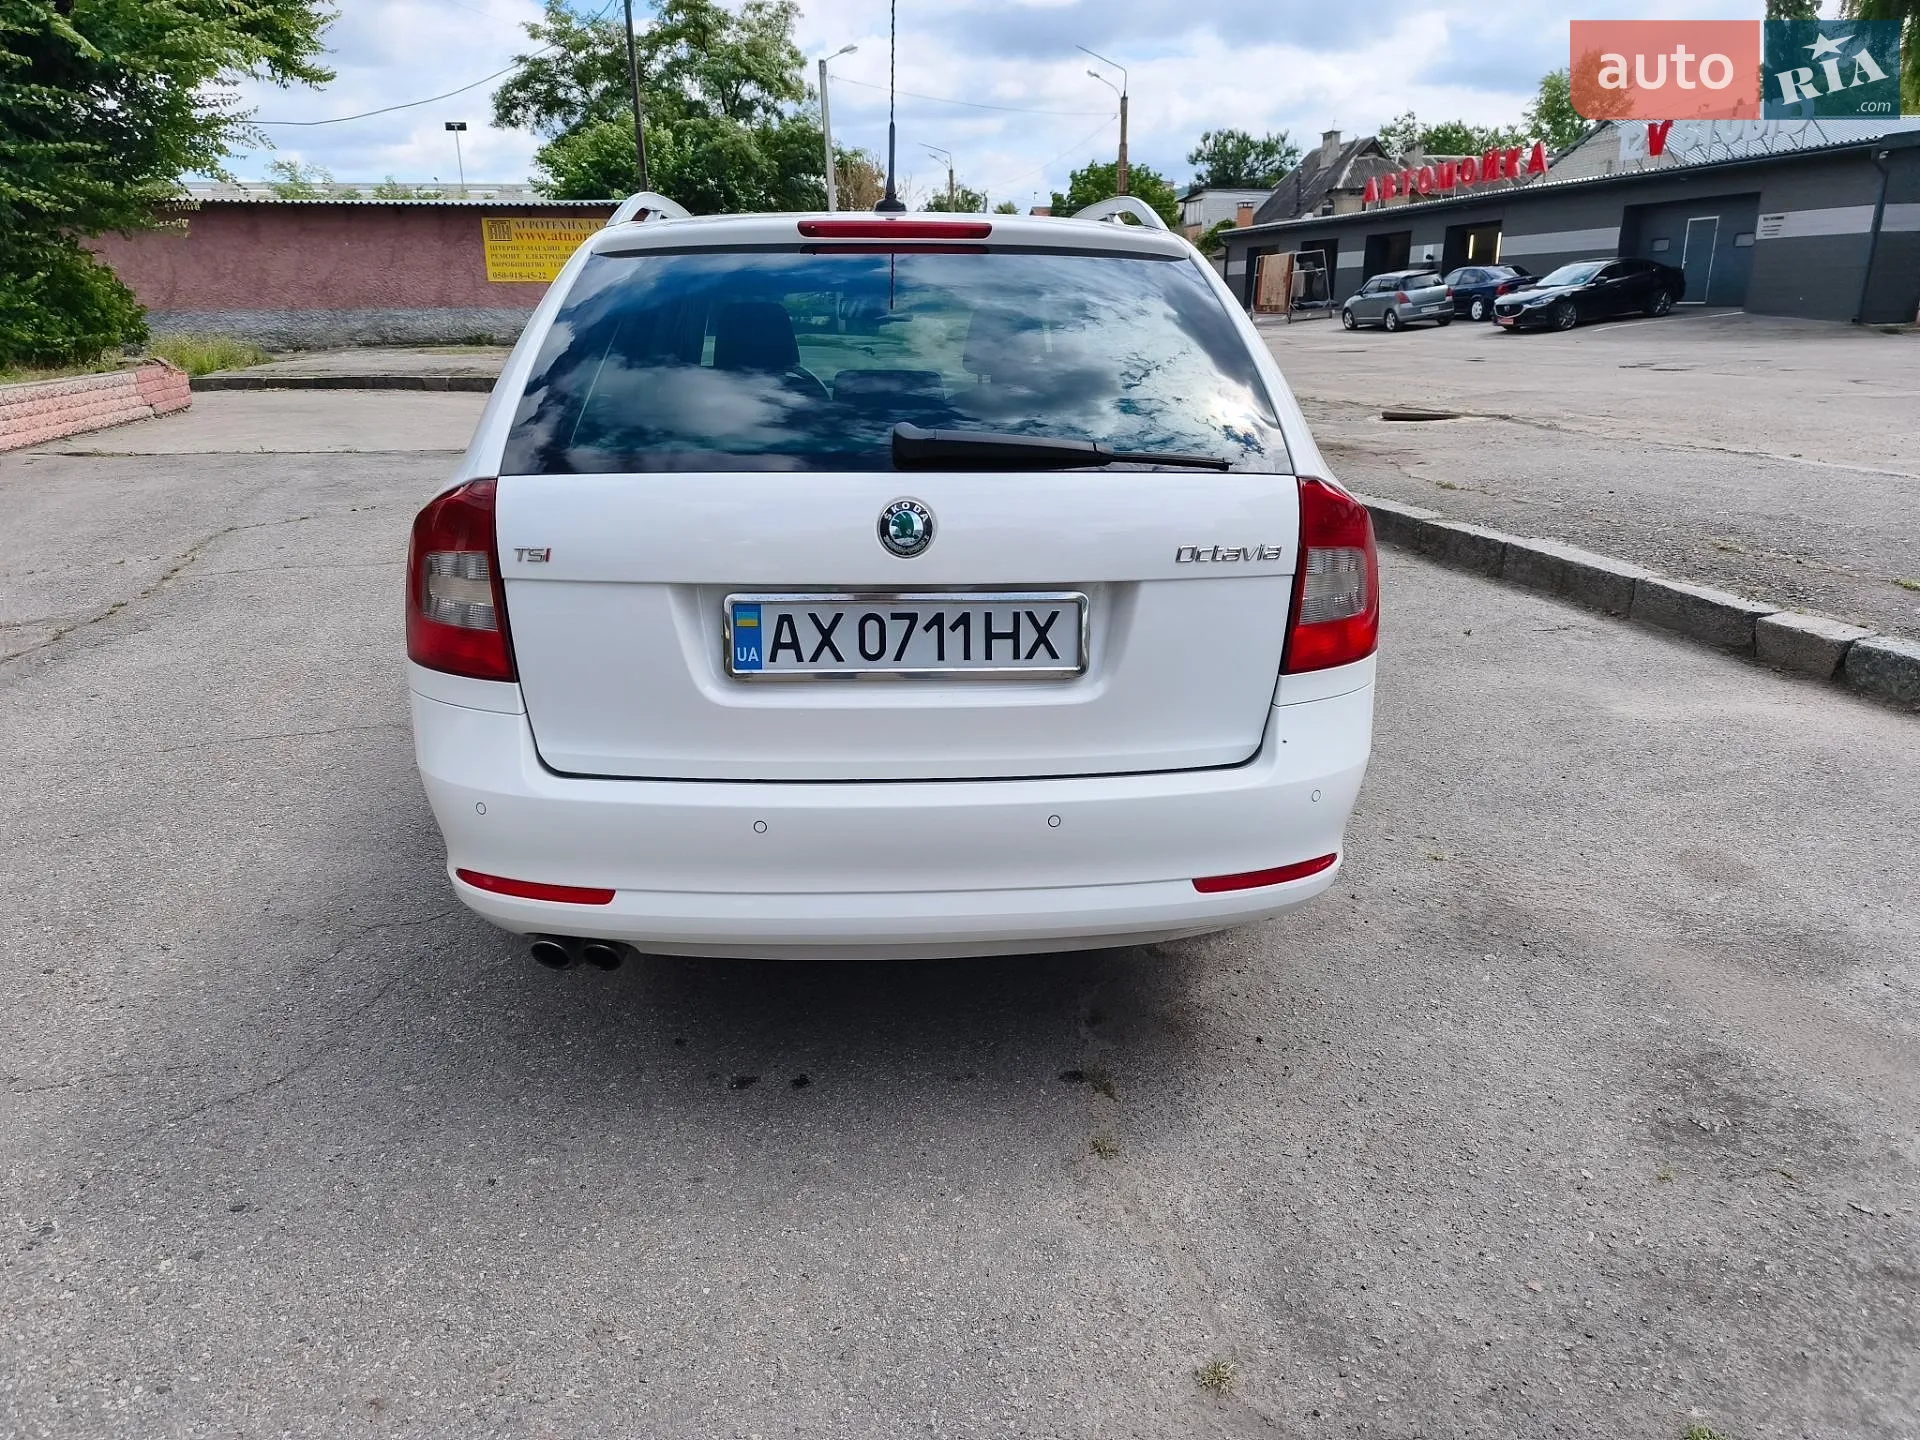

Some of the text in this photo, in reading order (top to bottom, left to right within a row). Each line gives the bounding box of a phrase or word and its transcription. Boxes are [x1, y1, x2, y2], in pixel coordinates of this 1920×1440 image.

[1363, 140, 1549, 203] АВТОМОЙКА
[513, 546, 552, 563] TSI
[1175, 544, 1282, 563] Octavia
[769, 610, 1061, 663] AX 0711 HX
[737, 648, 760, 662] UA
